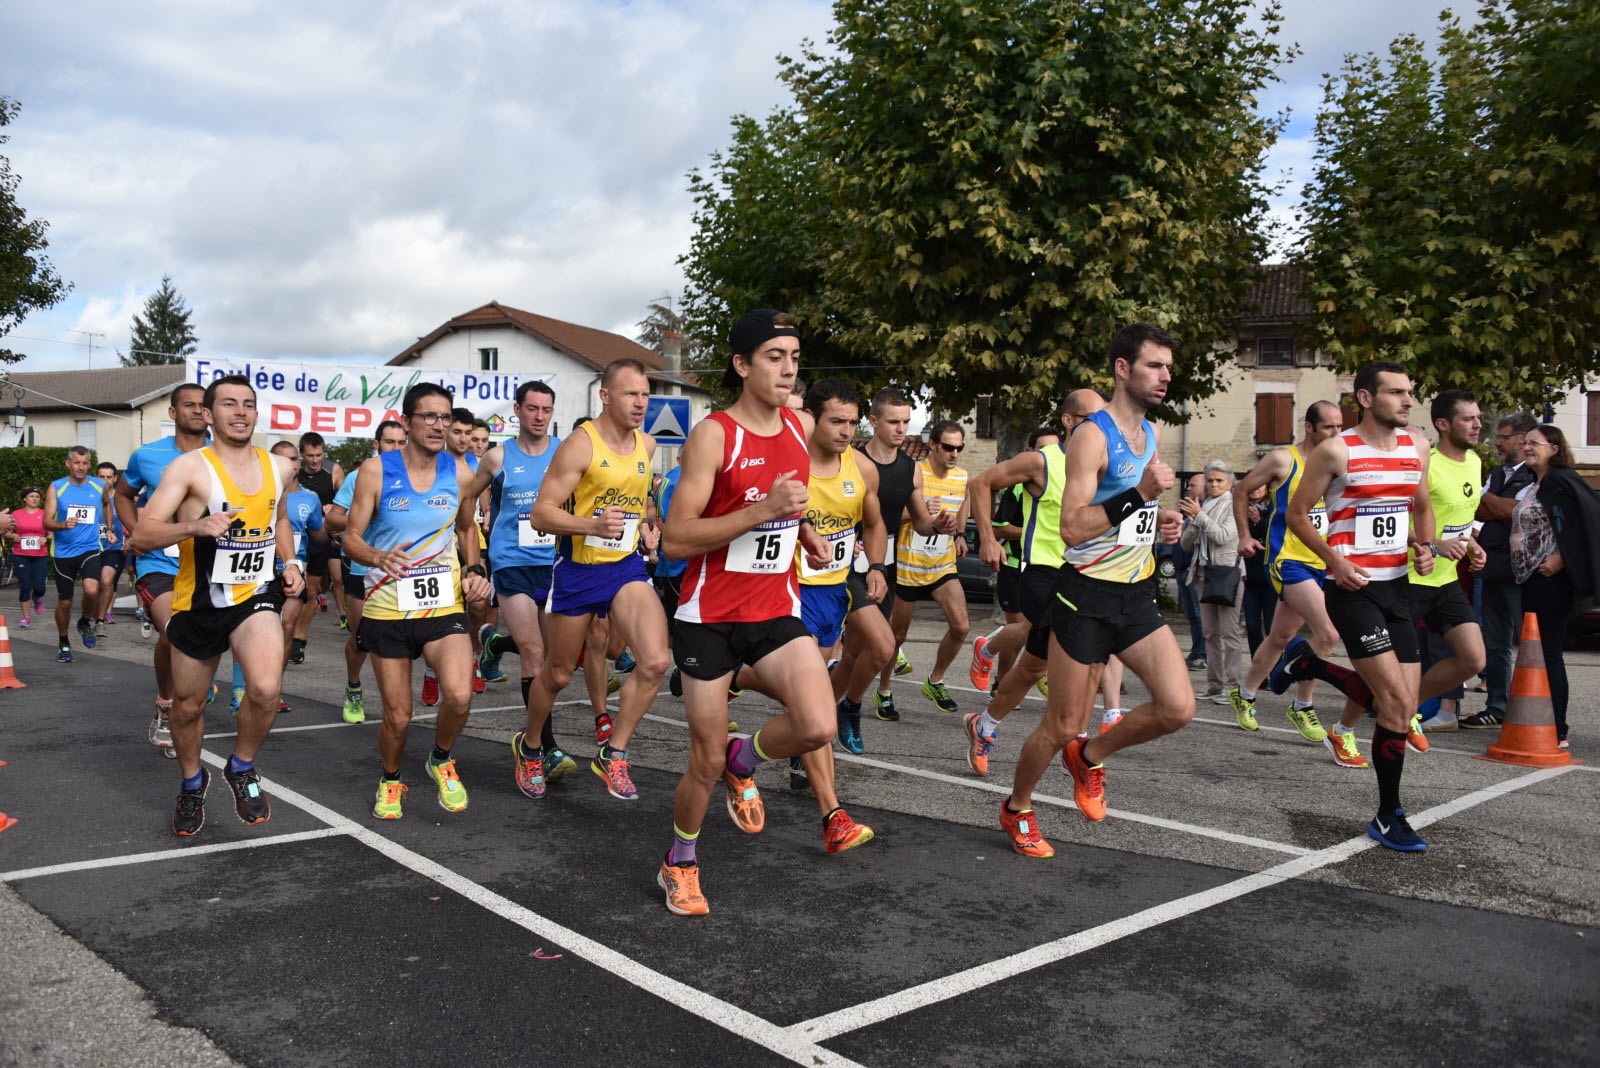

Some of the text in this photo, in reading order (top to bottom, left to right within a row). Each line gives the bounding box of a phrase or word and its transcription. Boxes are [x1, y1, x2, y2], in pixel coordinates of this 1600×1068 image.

[295, 372, 318, 392] de
[325, 373, 351, 401] la
[360, 369, 421, 410] Veyl
[463, 375, 518, 400] Polli
[270, 404, 401, 433] DEPA
[1136, 511, 1155, 534] 32
[1373, 516, 1396, 538] 69
[755, 534, 781, 560] 15
[834, 540, 846, 561] 6
[229, 551, 265, 573] 145
[414, 577, 439, 599] 58
